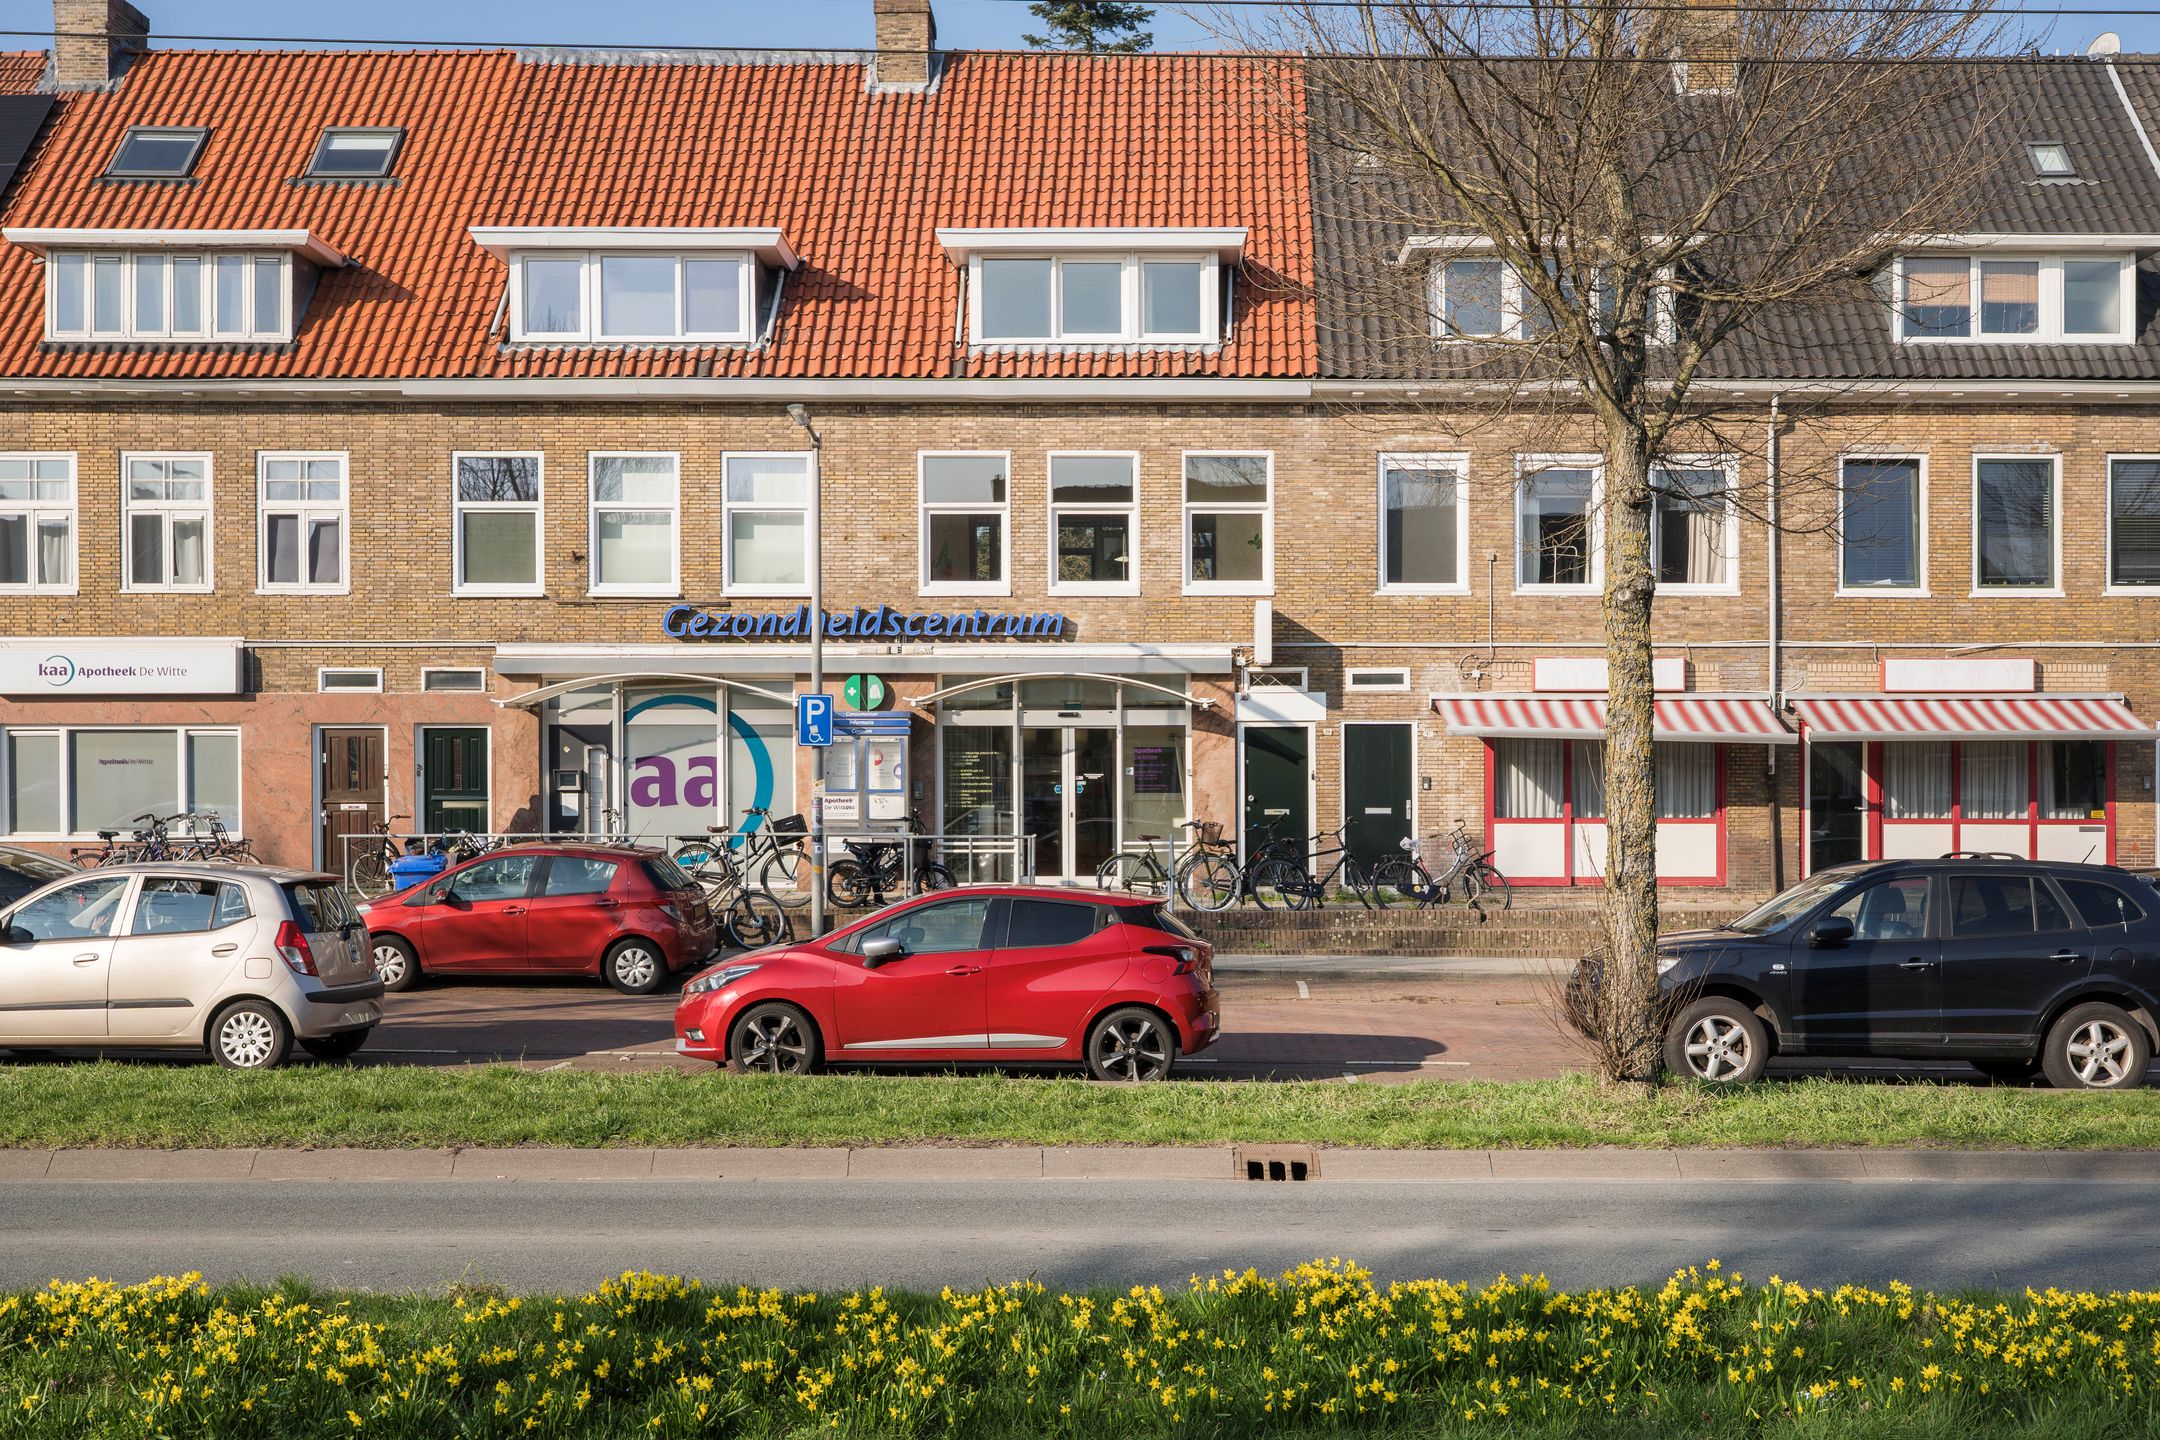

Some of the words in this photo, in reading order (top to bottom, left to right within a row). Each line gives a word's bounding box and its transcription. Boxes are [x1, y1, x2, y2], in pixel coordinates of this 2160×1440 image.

[662, 604, 1063, 638] Gezondheidscentrum
[39, 663, 68, 676] kaa
[78, 666, 137, 679] Apotheek
[139, 666, 155, 677] De
[157, 666, 188, 677] Witte
[807, 699, 825, 725] P
[824, 797, 854, 805] Apotheek
